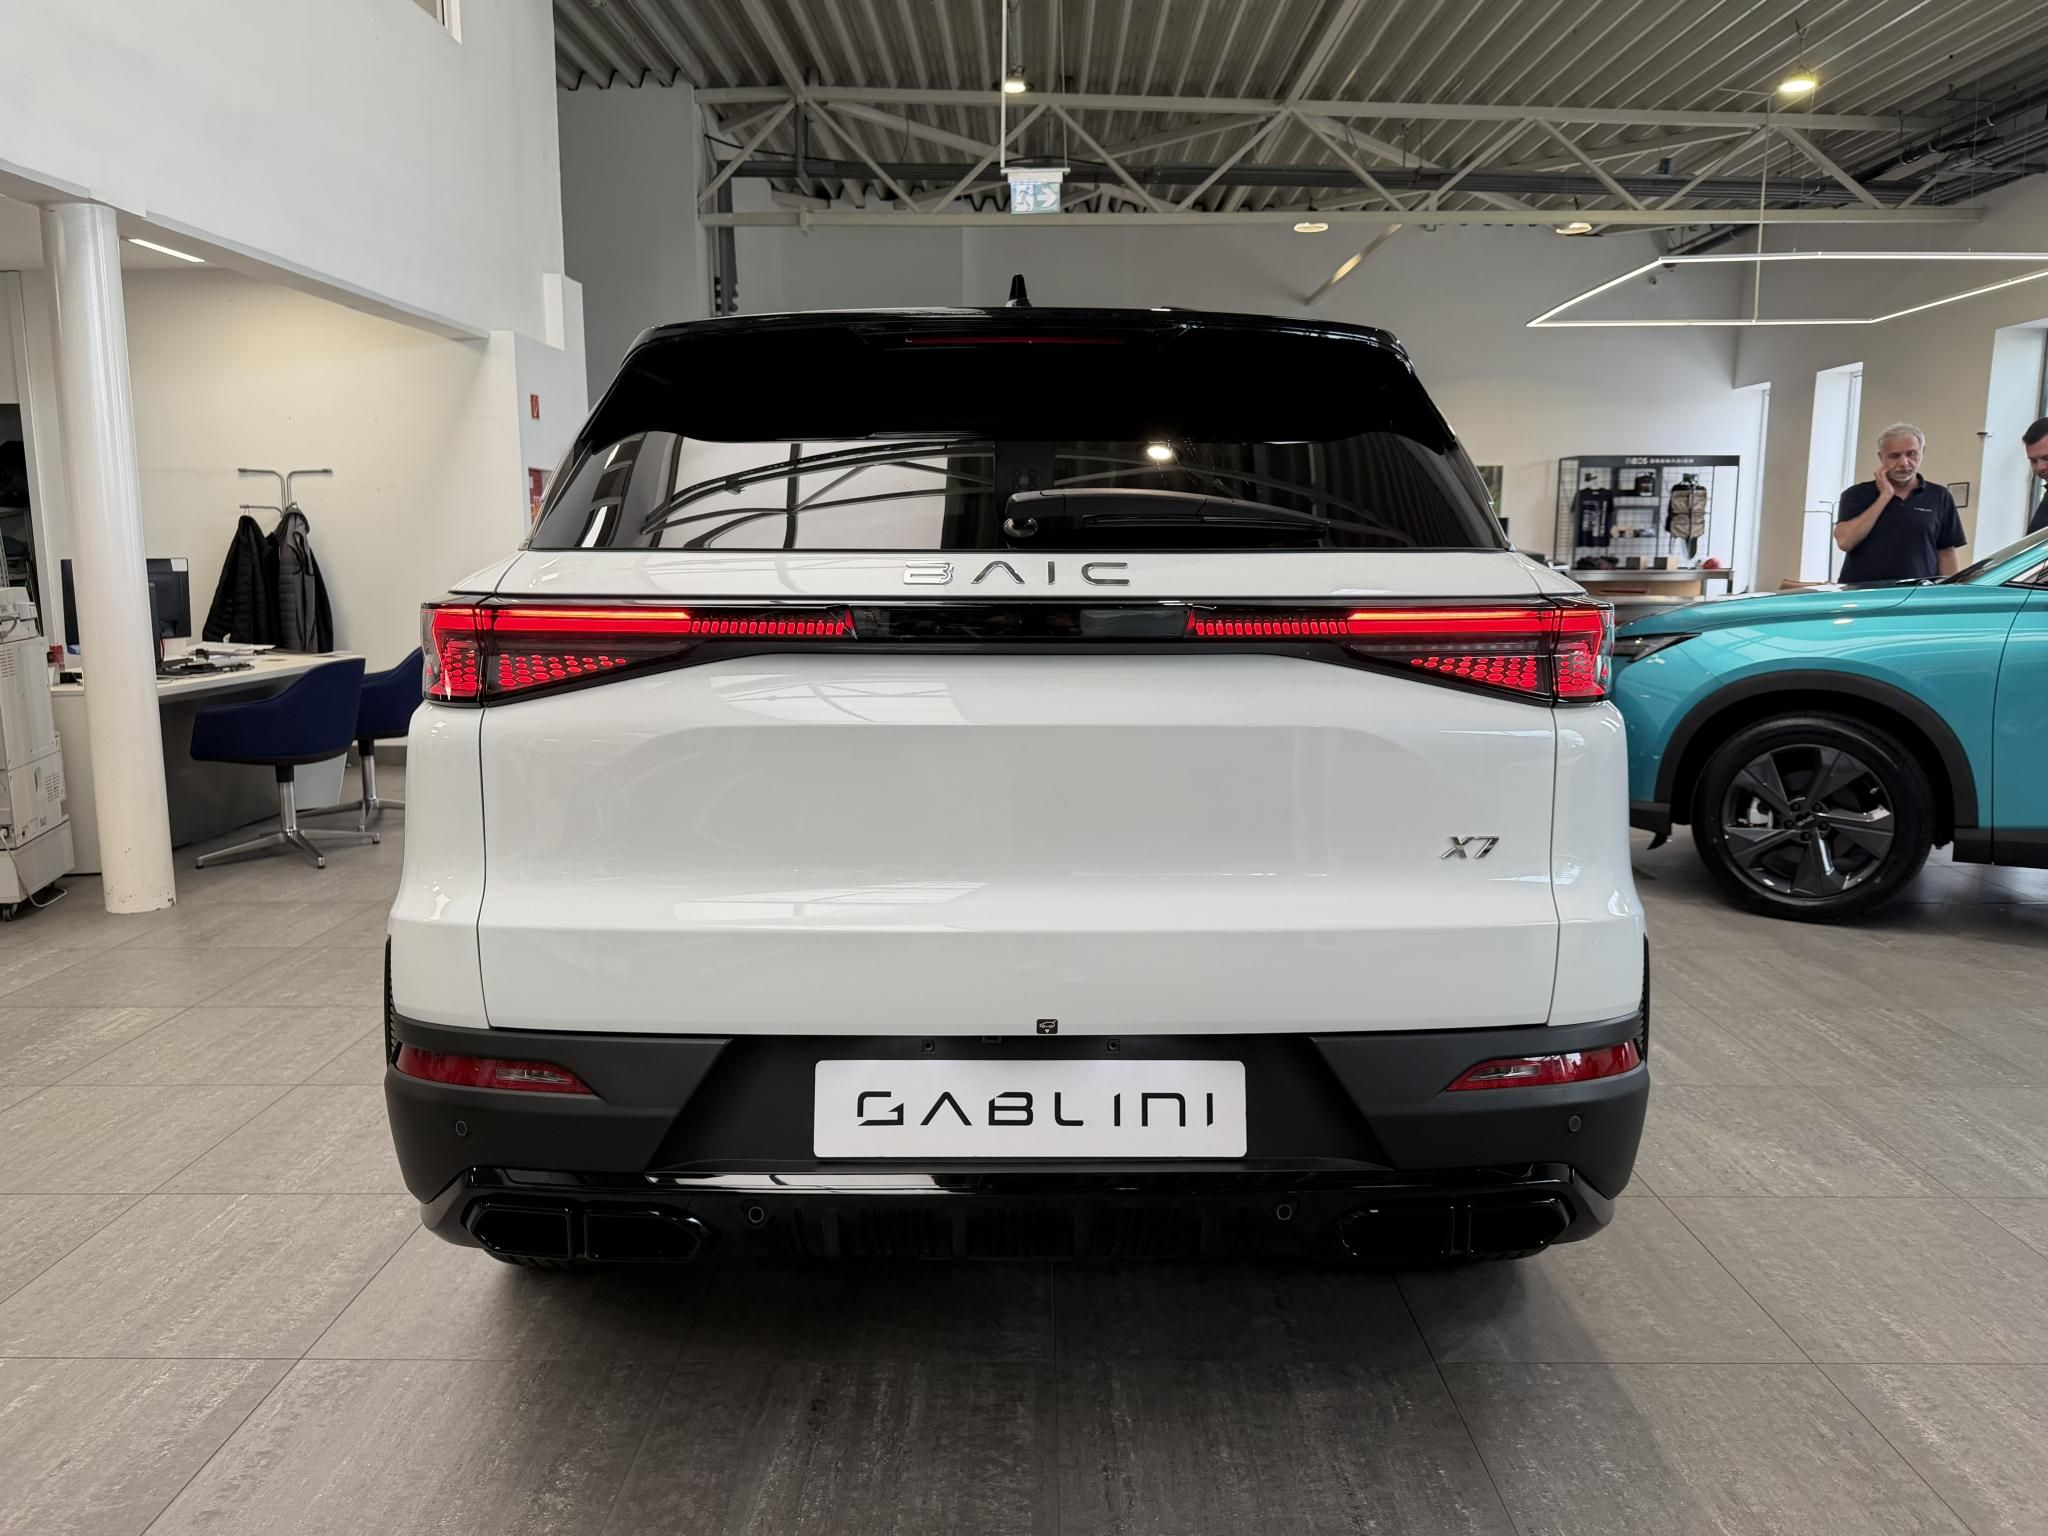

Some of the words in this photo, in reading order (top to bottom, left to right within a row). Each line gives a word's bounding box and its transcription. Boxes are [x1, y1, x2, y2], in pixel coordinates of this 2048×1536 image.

[903, 560, 1130, 586] BAIC
[1441, 835, 1500, 859] X7
[857, 1091, 1213, 1126] GABLINI
